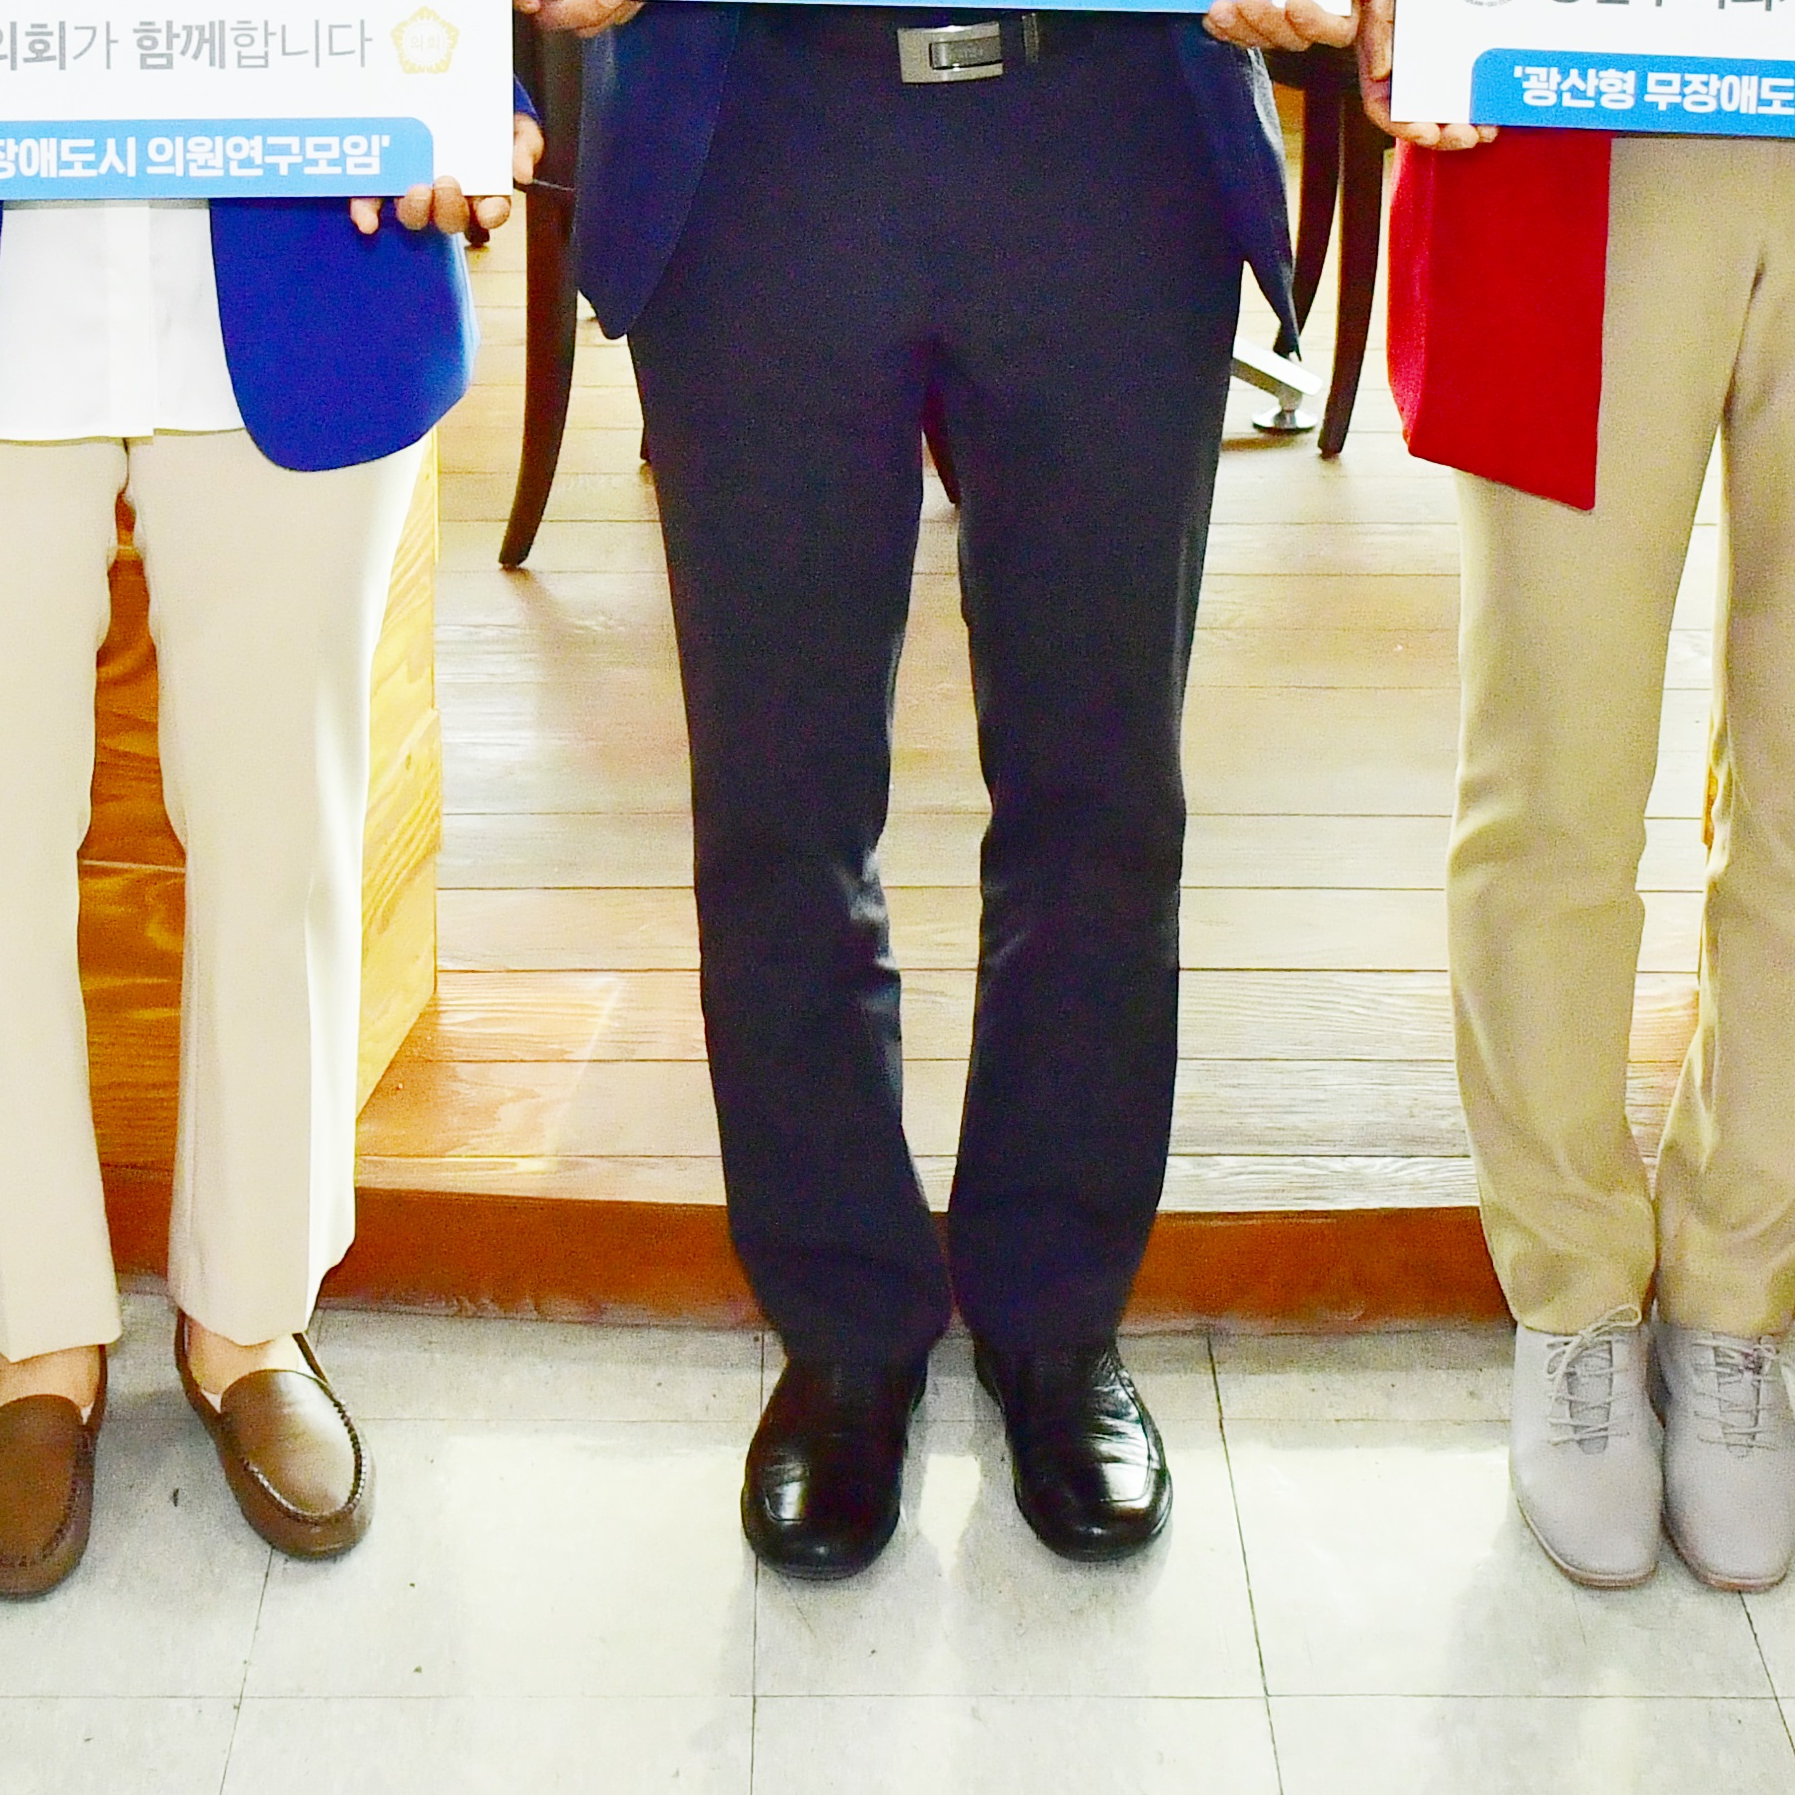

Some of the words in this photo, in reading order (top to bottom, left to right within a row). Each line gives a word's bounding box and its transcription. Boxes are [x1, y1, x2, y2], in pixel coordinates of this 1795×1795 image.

[132, 19, 373, 71] 함께합니다
[1513, 65, 1637, 110] '광산형
[146, 134, 391, 178] 의원연구모임'
